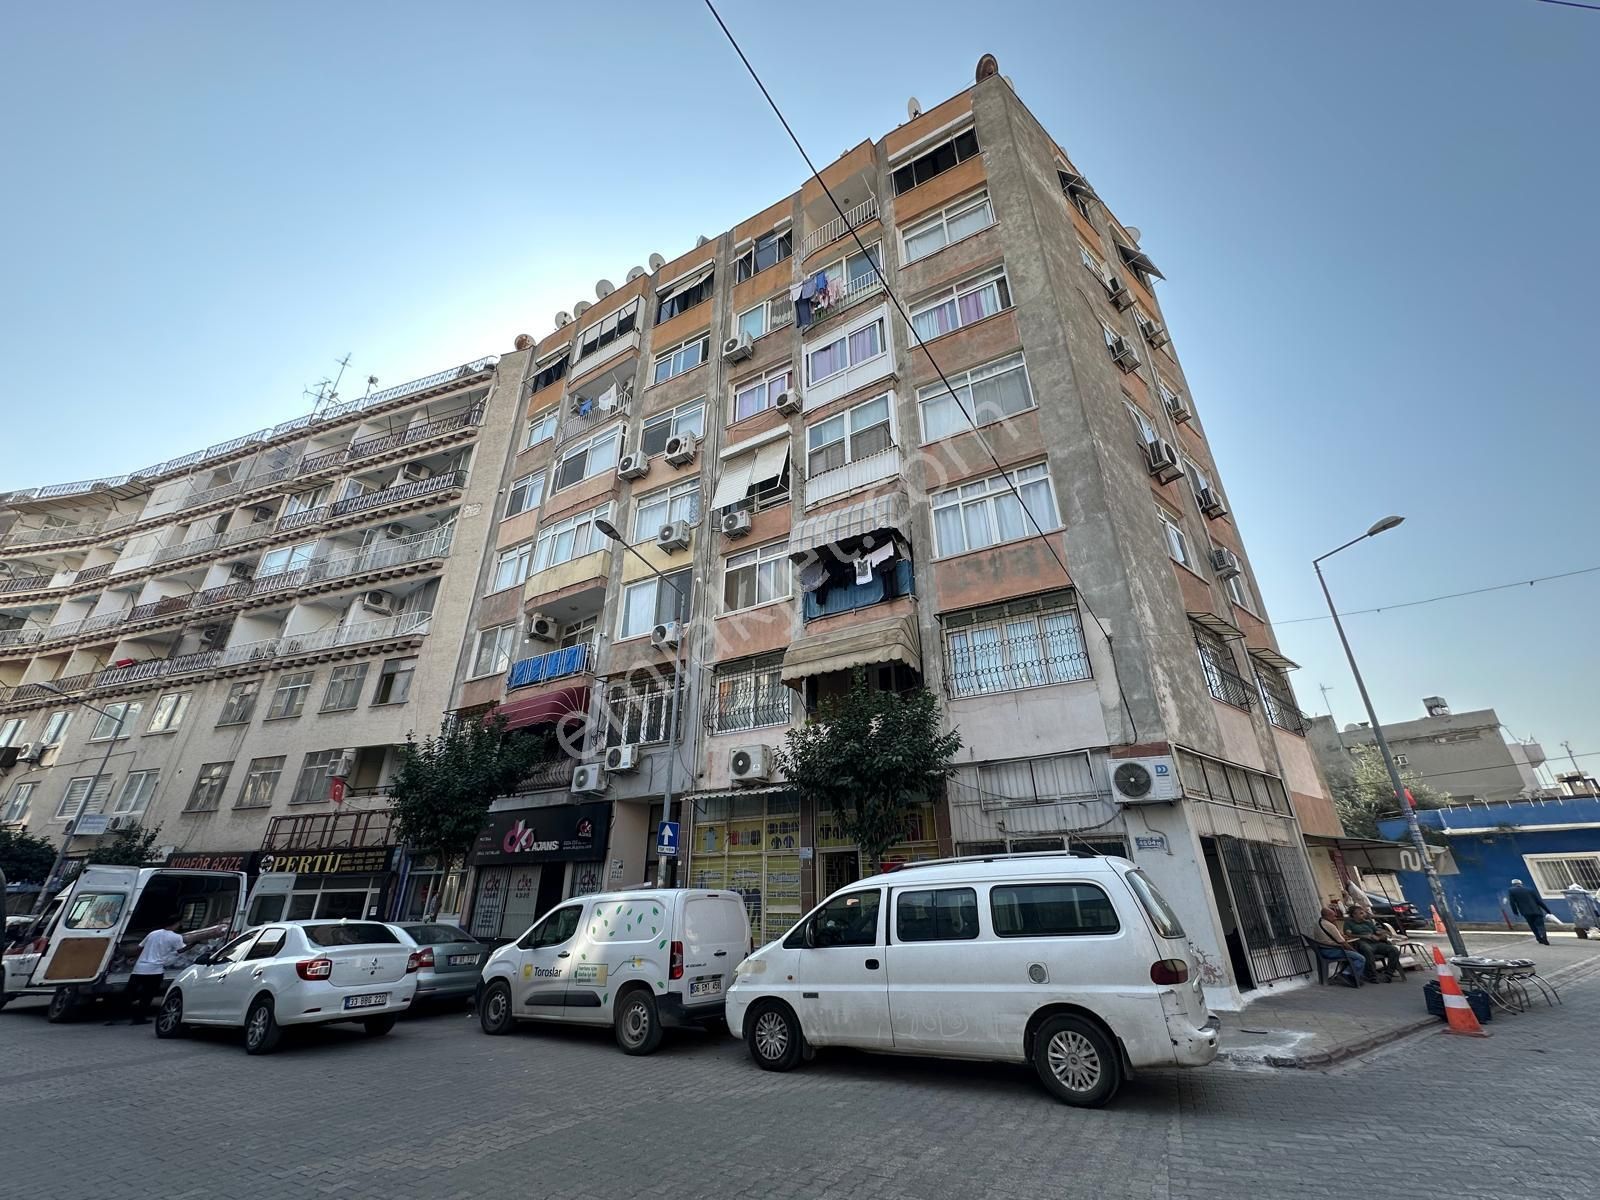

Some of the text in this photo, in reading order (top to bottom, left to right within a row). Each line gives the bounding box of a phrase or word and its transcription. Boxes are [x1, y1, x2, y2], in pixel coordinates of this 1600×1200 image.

[531, 840, 560, 852] AJANS
[210, 856, 244, 871] AZİZE
[534, 966, 562, 978] Toroslar
[350, 997, 358, 1006] 33
